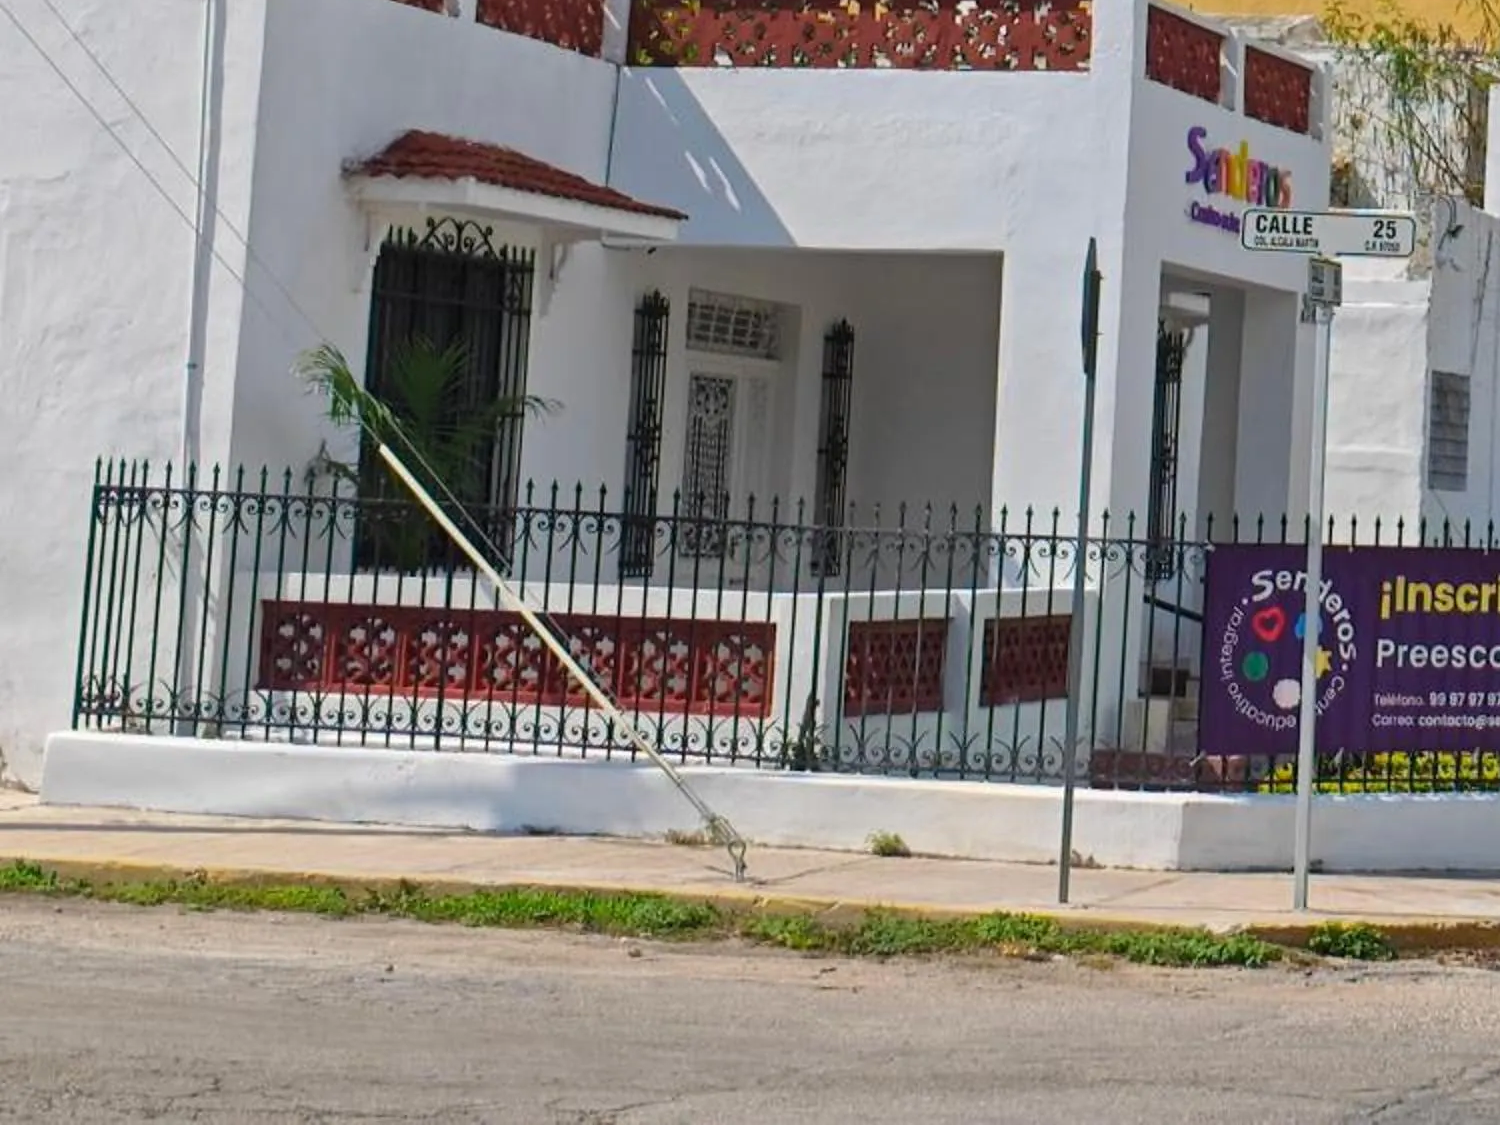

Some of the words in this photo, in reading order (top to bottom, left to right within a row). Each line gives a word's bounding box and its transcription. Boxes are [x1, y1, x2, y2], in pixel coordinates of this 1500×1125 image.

[1255, 214, 1313, 235] CALLE
[1373, 219, 1397, 239] 25
[1220, 606, 1245, 682] integral
[1228, 682, 1297, 731] educativo
